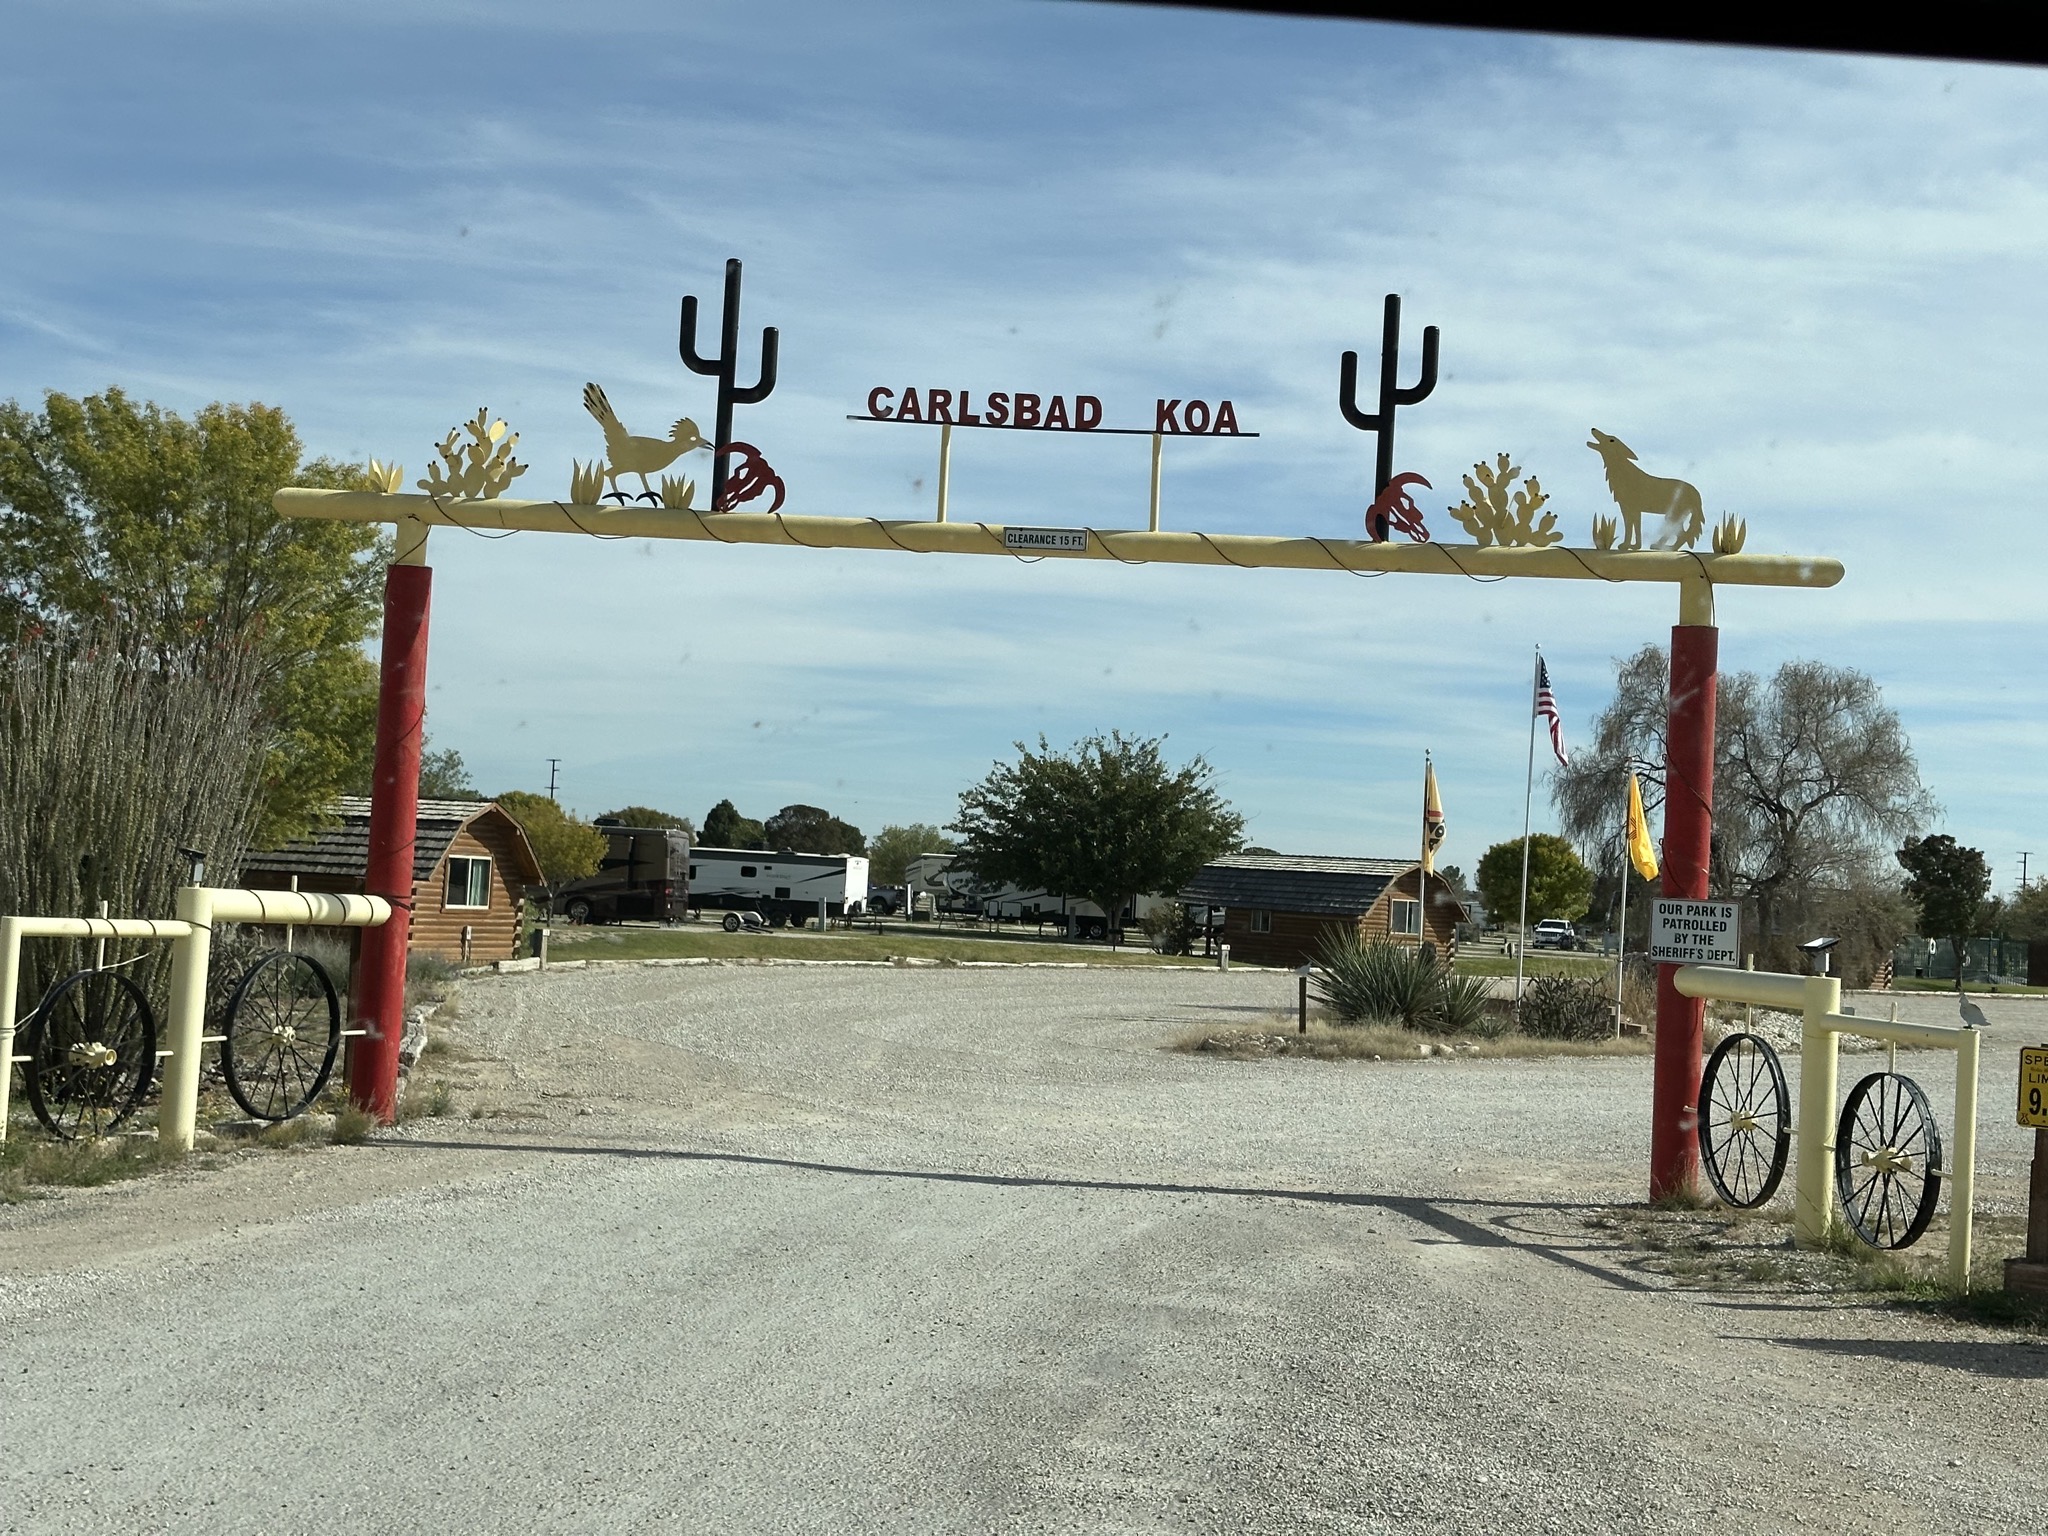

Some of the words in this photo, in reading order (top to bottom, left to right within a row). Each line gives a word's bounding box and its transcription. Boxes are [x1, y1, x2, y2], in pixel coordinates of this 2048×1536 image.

[867, 385, 1102, 430] CARLSBAD
[1156, 398, 1240, 434] KOA
[1008, 534, 1056, 544] CLEARANCE
[1060, 536, 1069, 545] 15
[1072, 537, 1083, 546] FT.
[1659, 903, 1682, 915] OUR
[1686, 905, 1717, 918] PARK
[1721, 907, 1732, 918] IS
[1662, 918, 1727, 932] PATROLLED
[1674, 933, 1688, 944] BY
[1692, 934, 1714, 945] THE
[1652, 946, 1703, 959] SHERIFF'S
[1707, 950, 1735, 961] DEPT.
